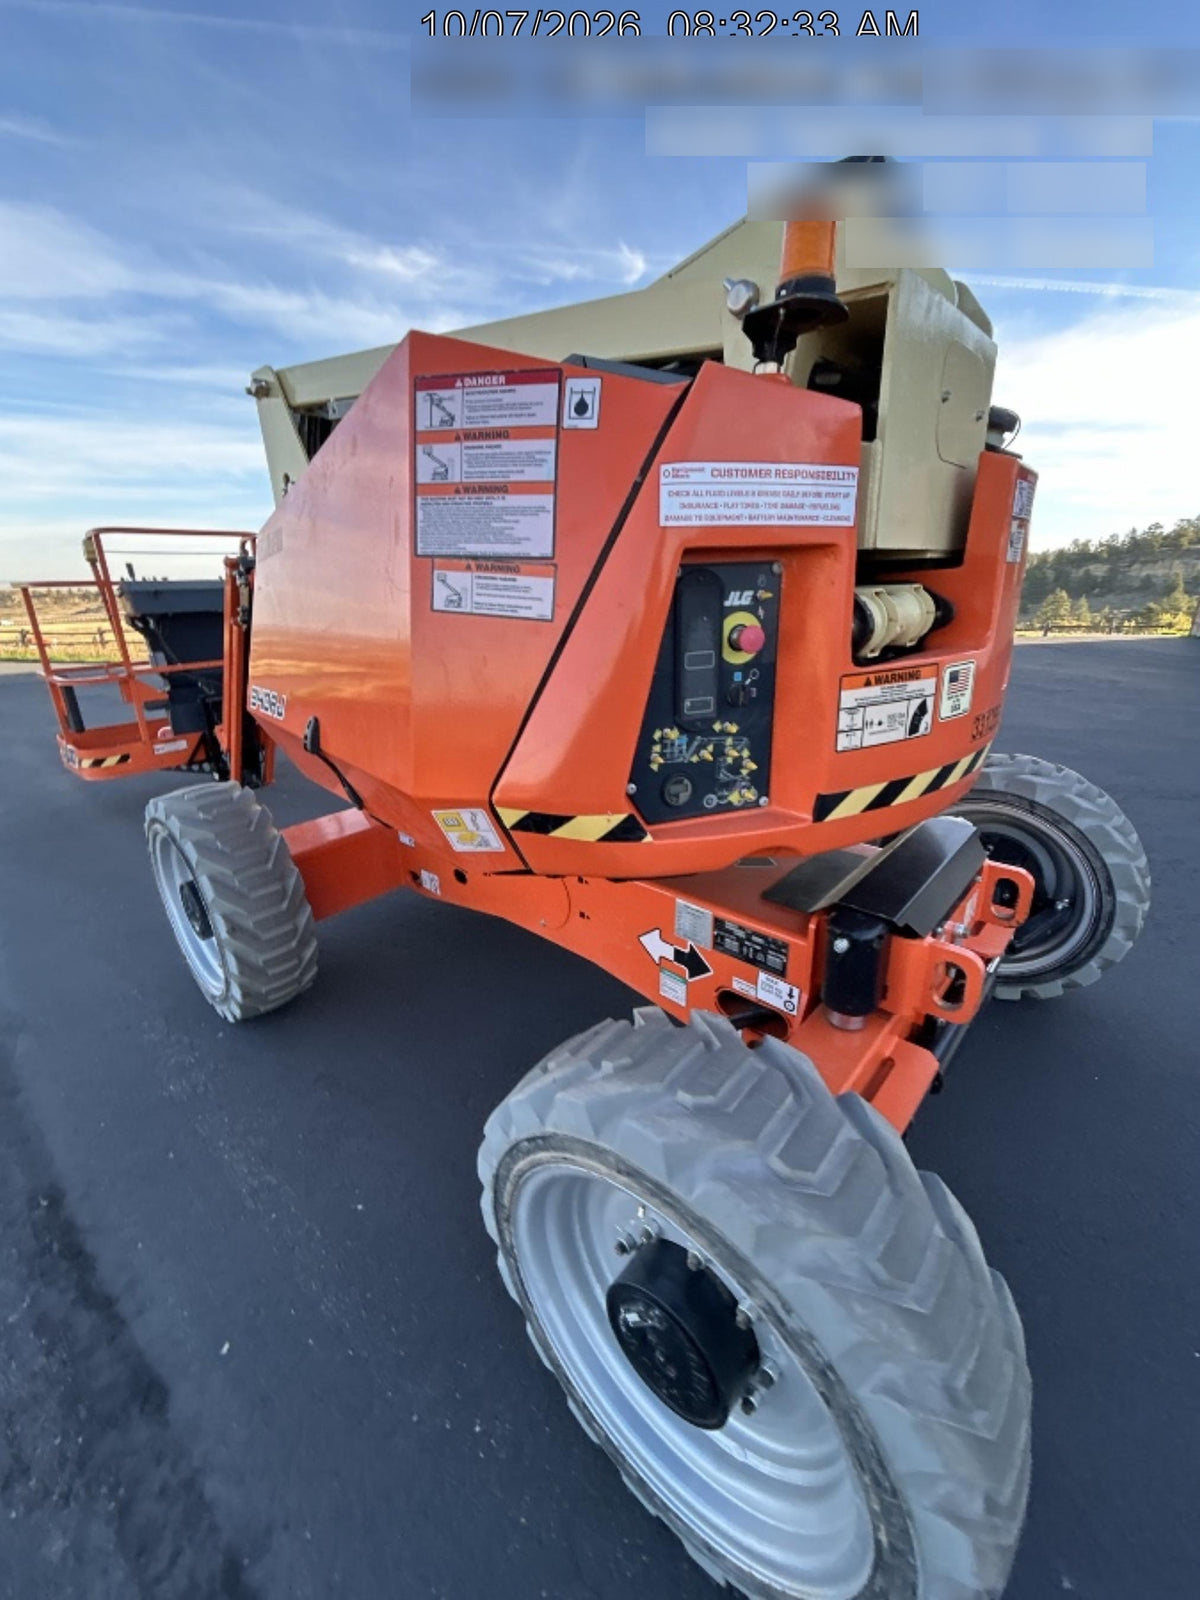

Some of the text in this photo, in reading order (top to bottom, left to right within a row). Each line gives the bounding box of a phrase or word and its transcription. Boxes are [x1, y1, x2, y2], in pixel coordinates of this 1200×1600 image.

[464, 375, 506, 387] DANGER
[462, 430, 510, 441] WARNING
[710, 467, 856, 481] CUSTOMER RESPONSIBILITY
[461, 484, 509, 494] WARNING
[475, 562, 521, 574] WARNING
[723, 590, 755, 607] JLG
[874, 669, 922, 685] WARNING
